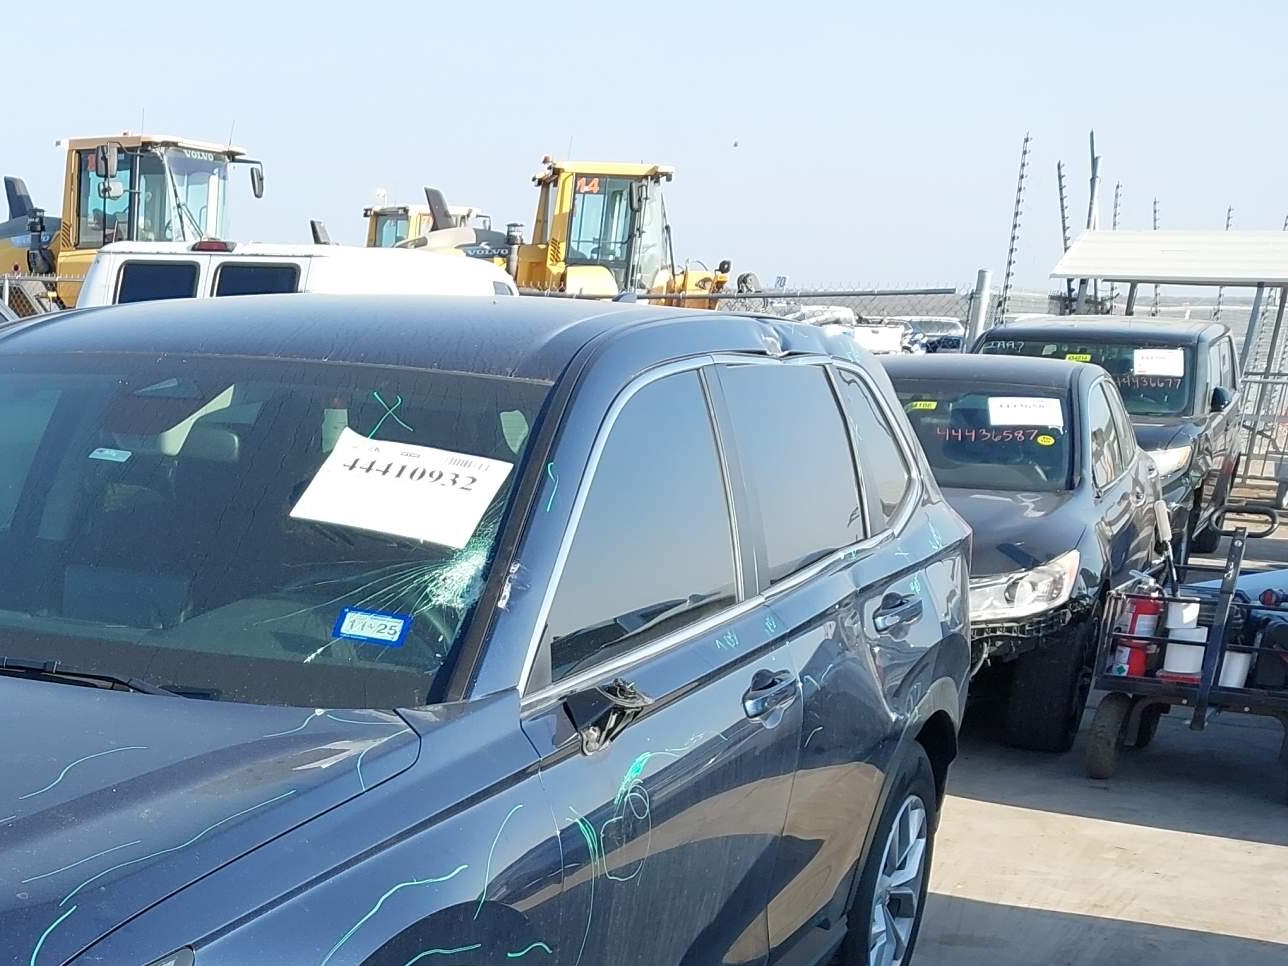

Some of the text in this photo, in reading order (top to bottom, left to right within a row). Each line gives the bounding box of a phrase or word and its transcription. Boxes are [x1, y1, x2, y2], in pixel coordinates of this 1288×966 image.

[183, 150, 215, 162] VOLVO
[576, 176, 600, 194] 14
[468, 248, 509, 256] VOLVO
[936, 427, 1039, 442] 44436587
[343, 457, 478, 491] 44410932
[376, 623, 398, 636] 25
